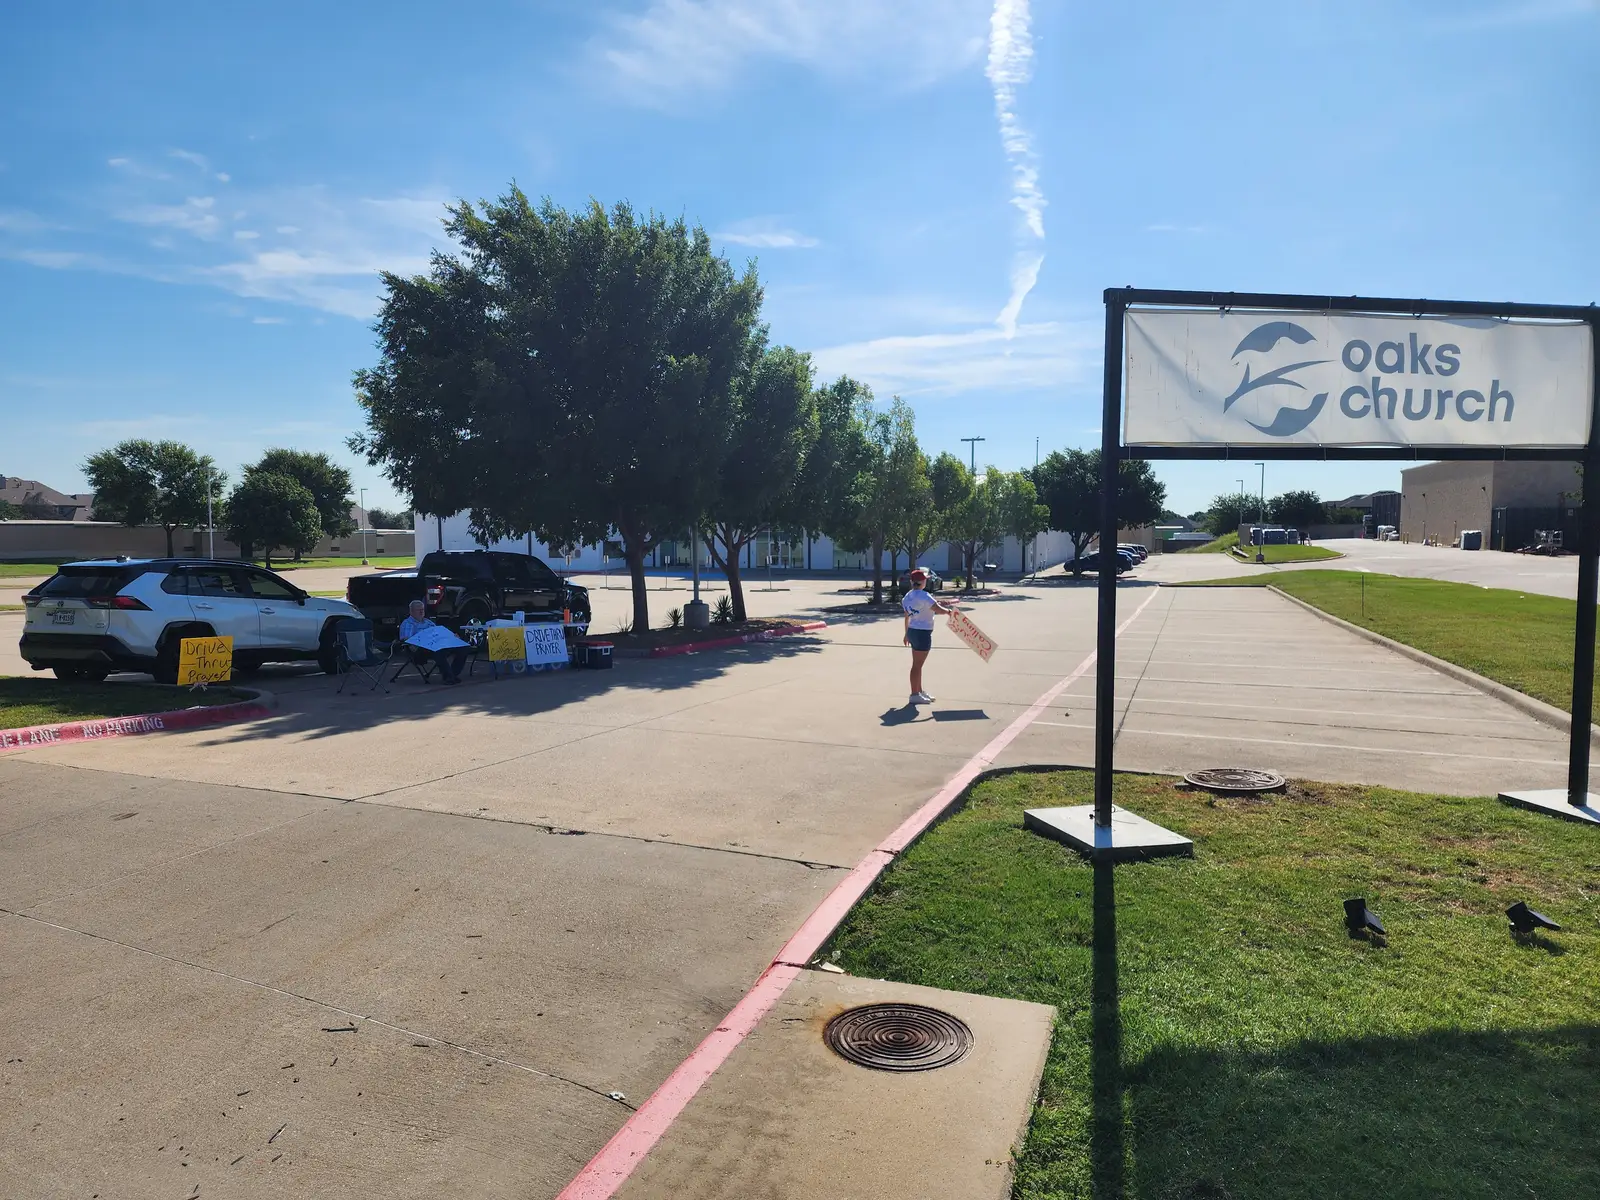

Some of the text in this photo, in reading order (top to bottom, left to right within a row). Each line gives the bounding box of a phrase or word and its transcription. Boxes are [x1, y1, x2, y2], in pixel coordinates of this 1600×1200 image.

[1341, 332, 1461, 377] oaks
[1340, 376, 1515, 422] church
[525, 628, 551, 643] DRIVE
[186, 641, 225, 655] Drive
[535, 642, 562, 655] PRAYER
[196, 656, 228, 669] Thru
[17, 728, 61, 746] LANE
[83, 722, 102, 738] NO
[105, 716, 165, 735] PARKING
